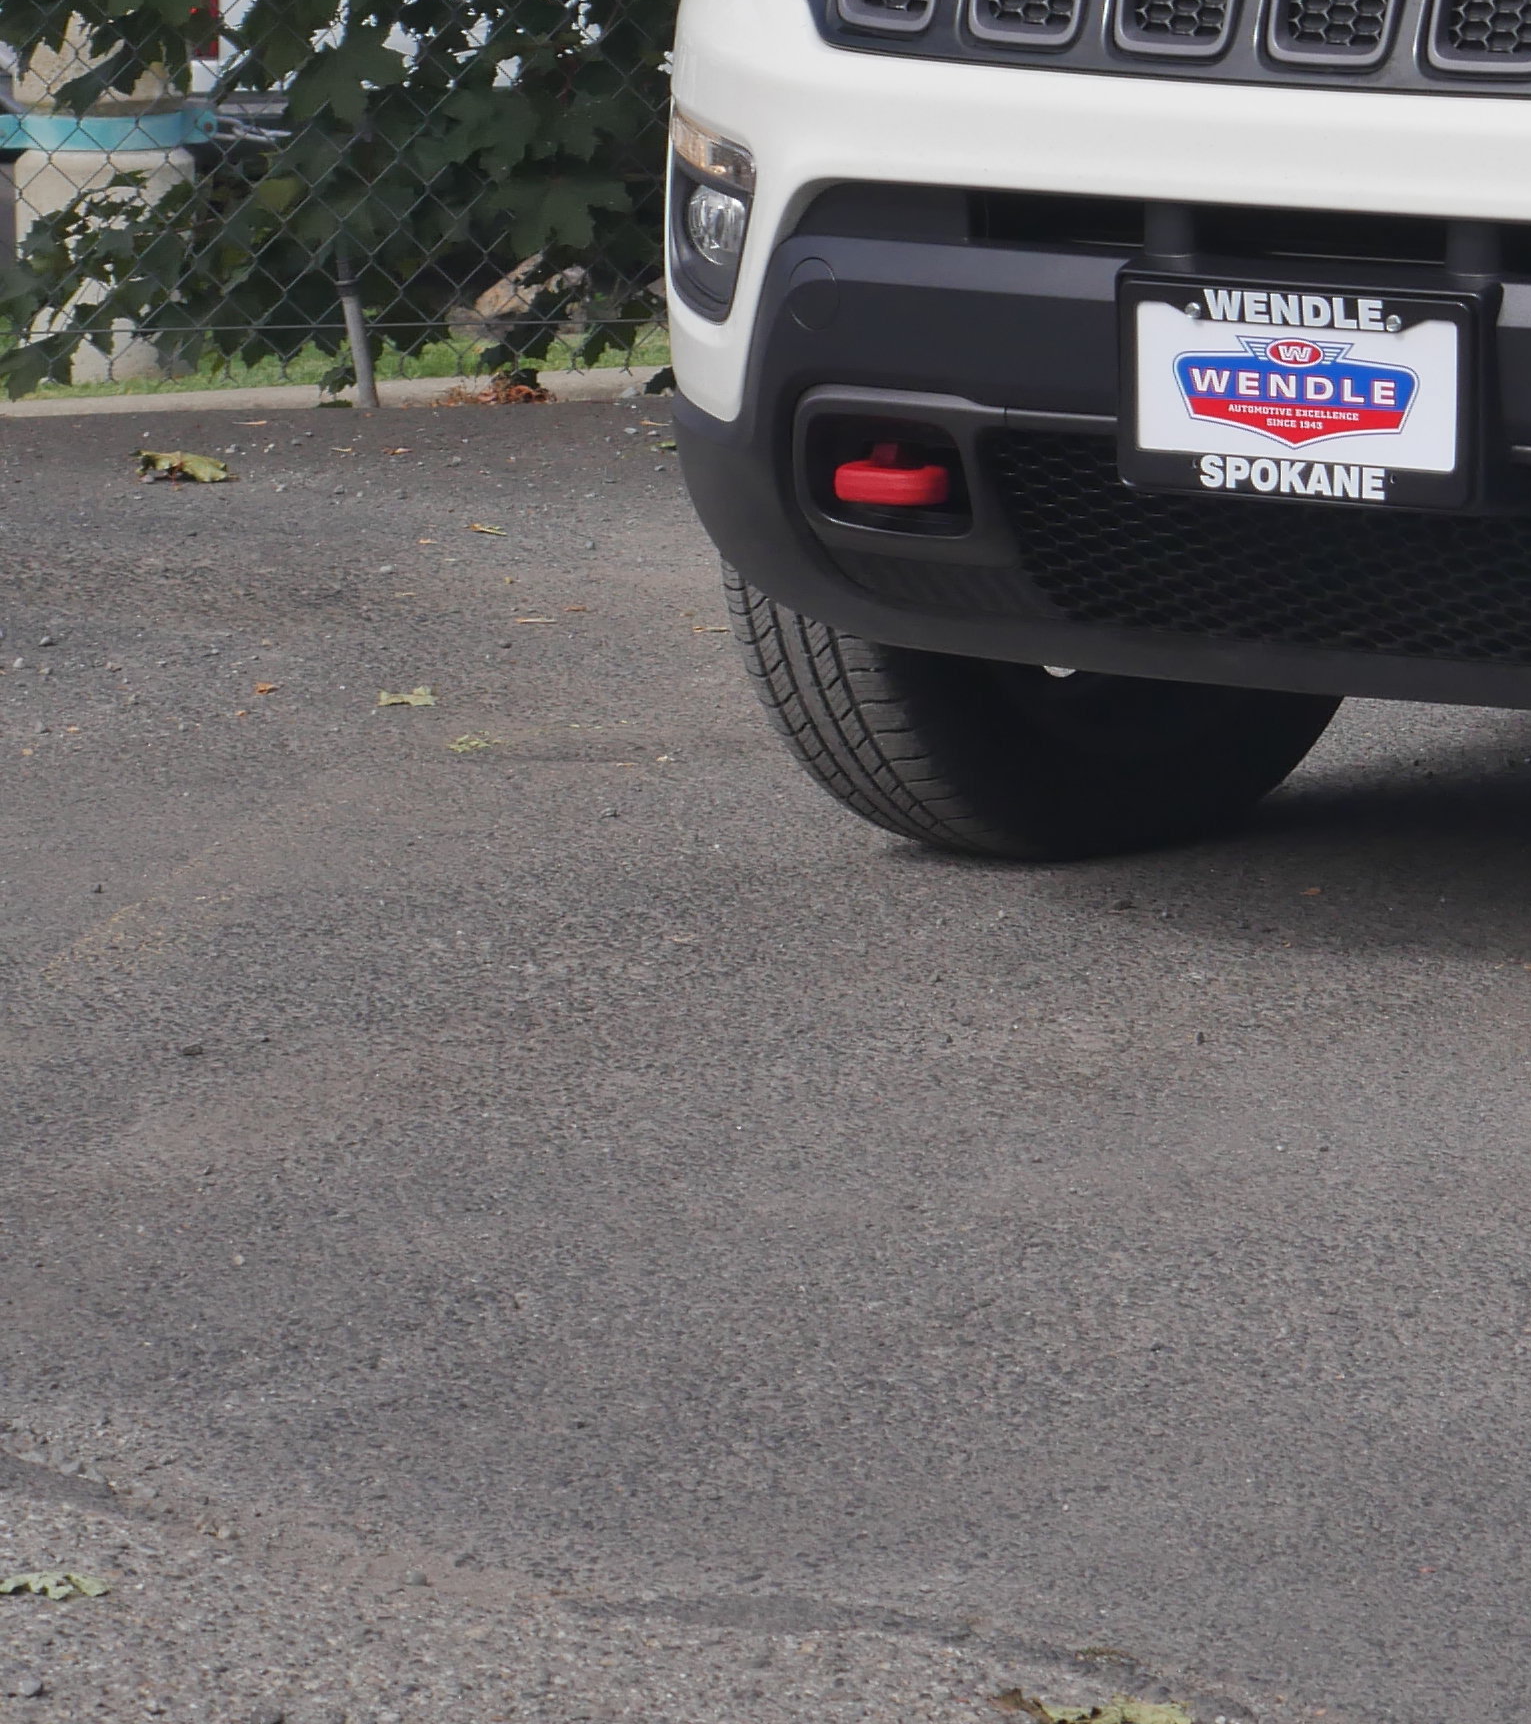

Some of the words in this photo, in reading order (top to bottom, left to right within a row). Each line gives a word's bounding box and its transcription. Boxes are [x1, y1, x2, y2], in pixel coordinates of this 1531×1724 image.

[1203, 289, 1385, 331] WENDLE
[1189, 367, 1396, 405] WENDLE
[1228, 403, 1293, 417] AUTOMOTIVE
[1295, 409, 1360, 421] EXCELLENCE
[1266, 418, 1297, 428] SINCE
[1299, 420, 1323, 430] 1943
[1199, 455, 1386, 501] SPOKANE
